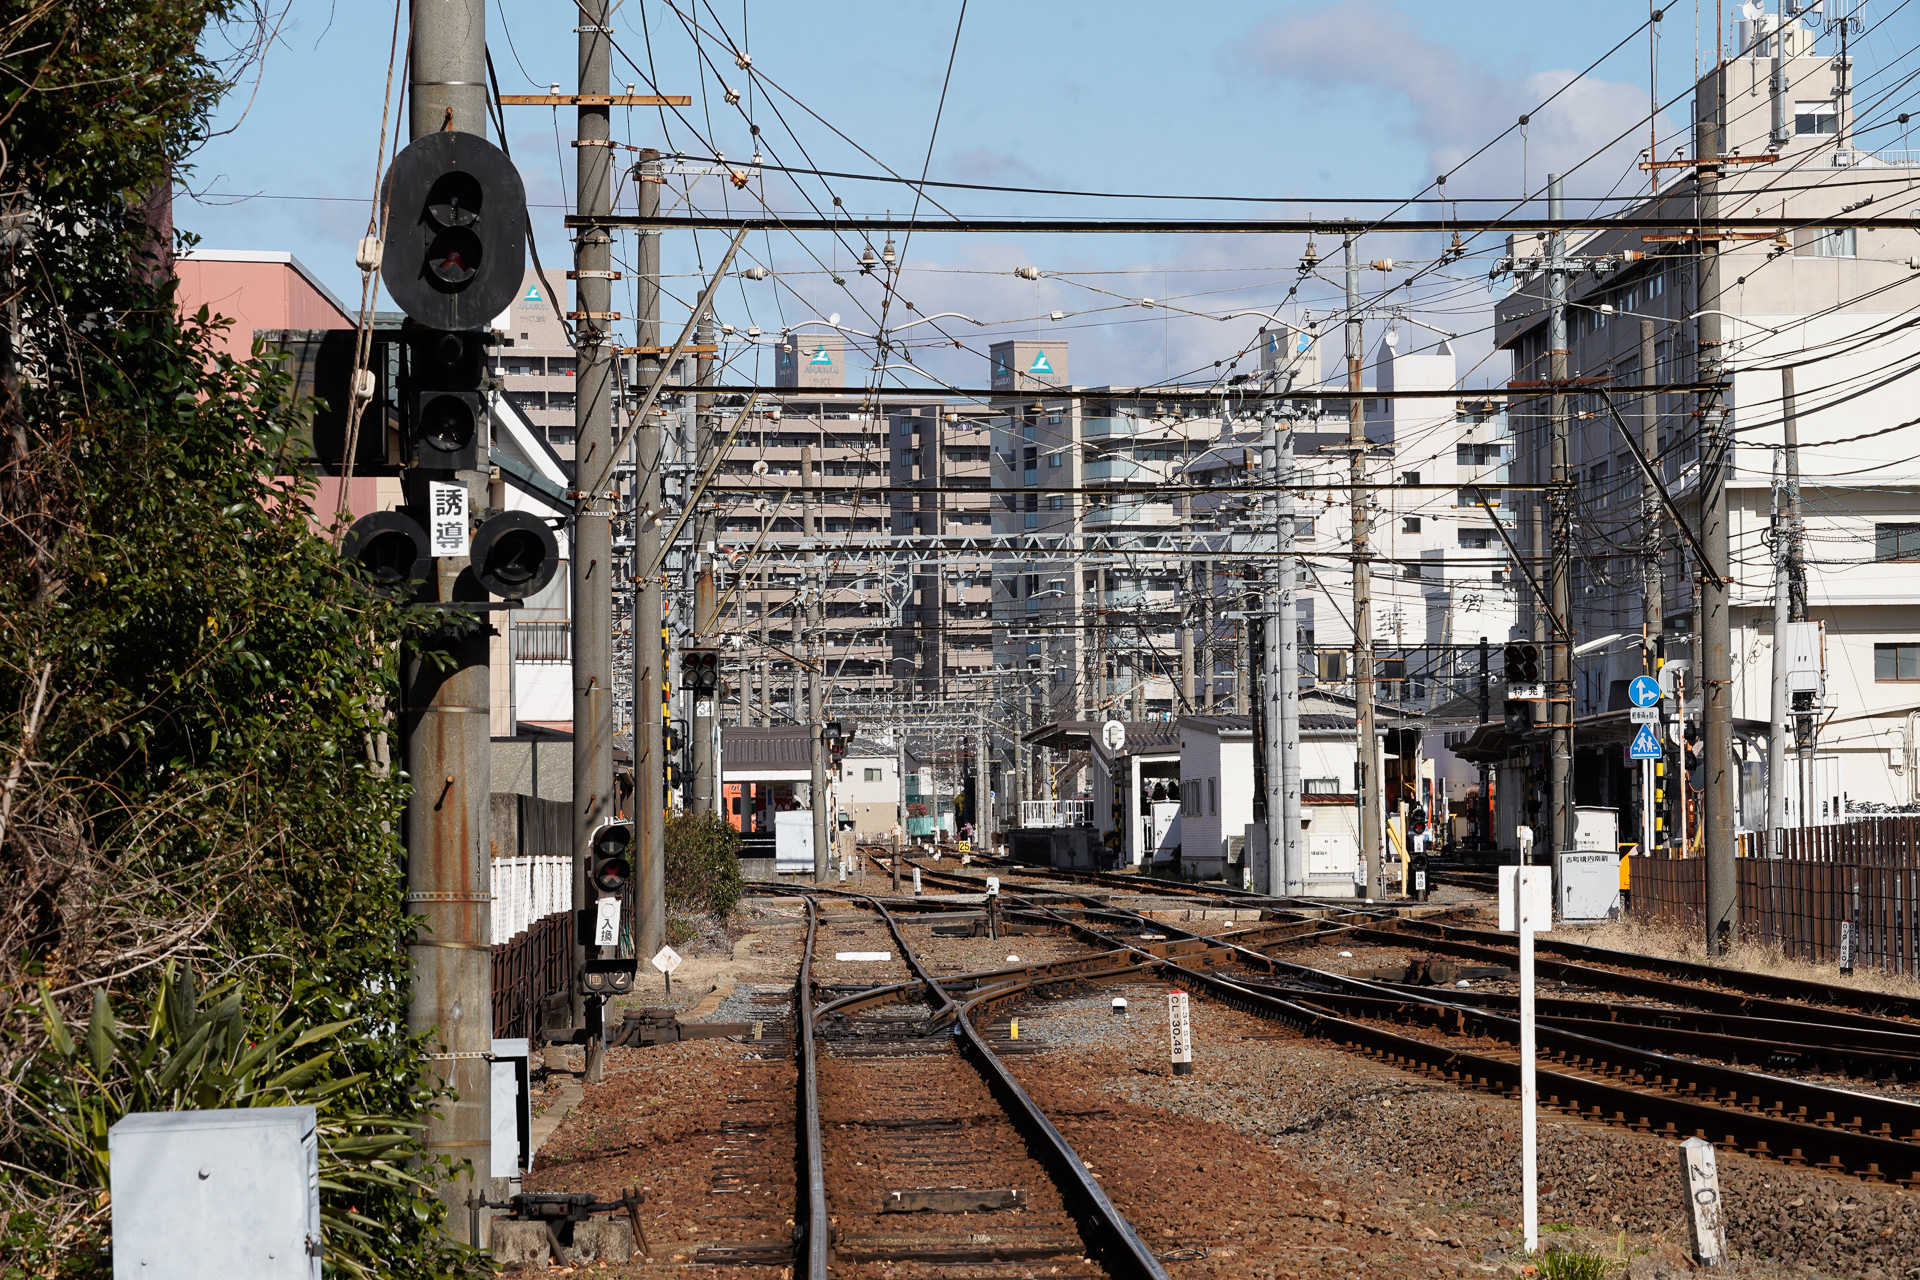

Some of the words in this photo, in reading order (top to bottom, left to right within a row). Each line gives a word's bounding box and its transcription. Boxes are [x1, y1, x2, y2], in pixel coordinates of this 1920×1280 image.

[436, 489, 463, 549] 誘導
[1513, 685, 1538, 696] 特発
[959, 842, 970, 851] 25
[601, 918, 613, 942] 入換
[1171, 996, 1182, 1055] CL=30.48
[1690, 1162, 1717, 1205] 20
